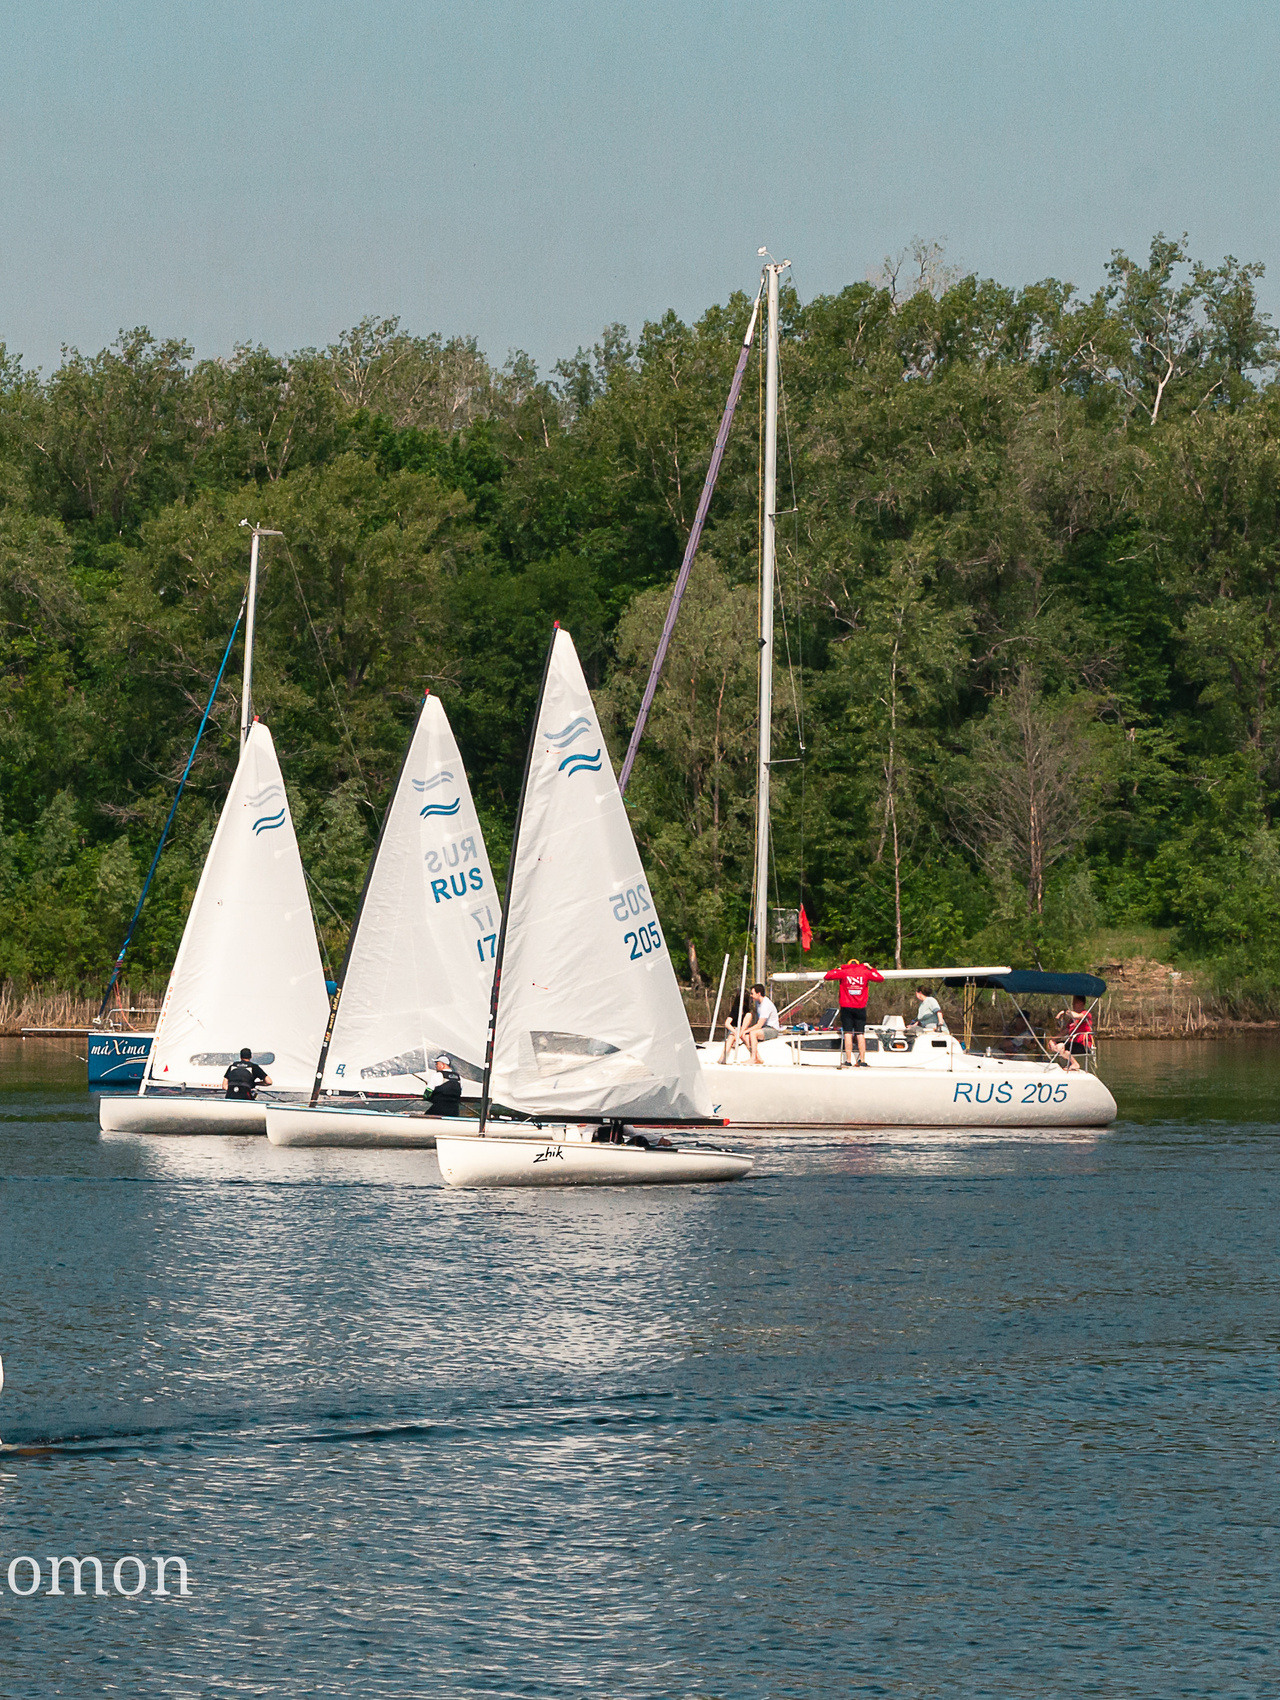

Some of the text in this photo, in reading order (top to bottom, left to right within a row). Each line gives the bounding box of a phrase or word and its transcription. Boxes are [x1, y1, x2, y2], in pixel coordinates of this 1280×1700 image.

[431, 867, 484, 903] RUS
[477, 933, 497, 962] 17
[624, 921, 661, 961] 205
[953, 1082, 1068, 1103] RUS 205
[533, 1145, 564, 1163] zhik
